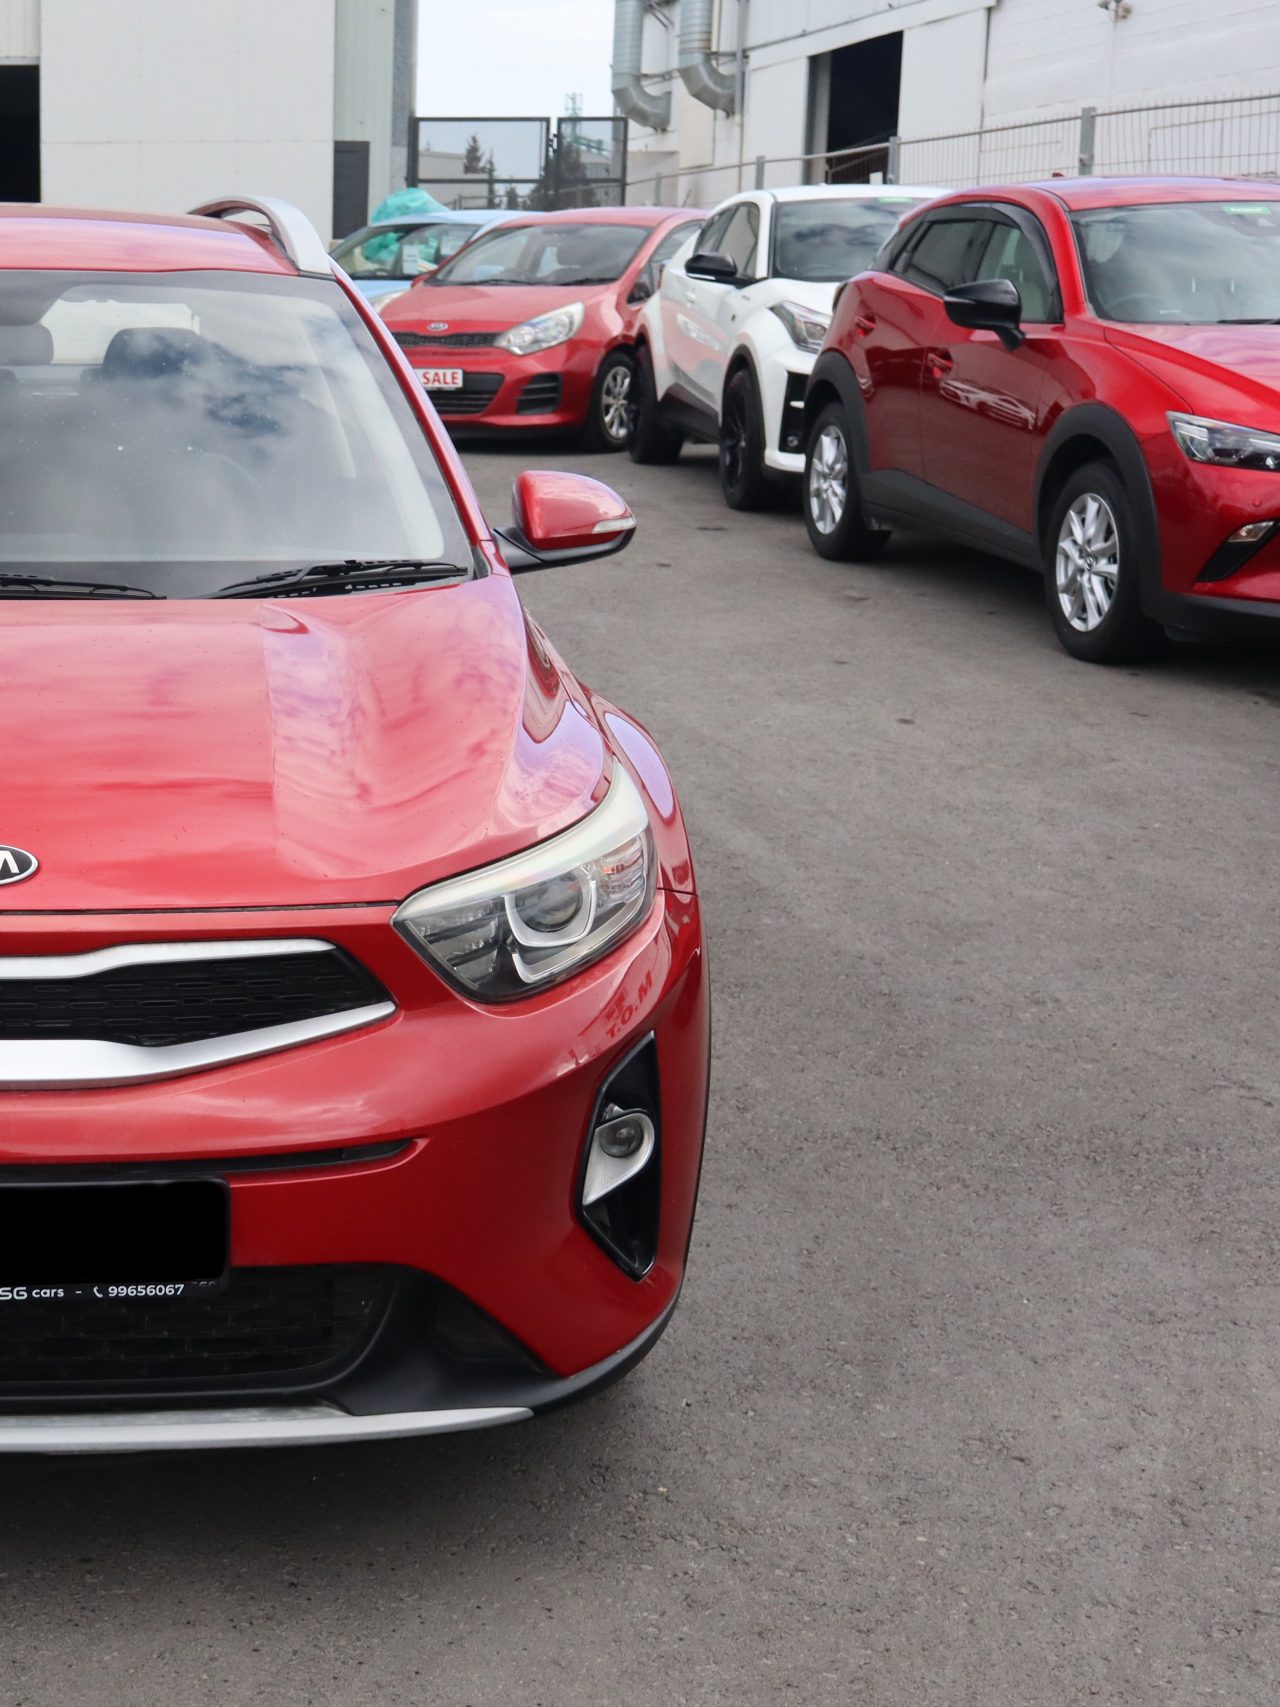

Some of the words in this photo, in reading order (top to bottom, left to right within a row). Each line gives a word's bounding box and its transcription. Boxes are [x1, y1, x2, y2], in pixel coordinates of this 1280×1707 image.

[422, 371, 459, 385] SALE
[31, 1287, 65, 1298] cars
[108, 1283, 185, 1297] 99656067
